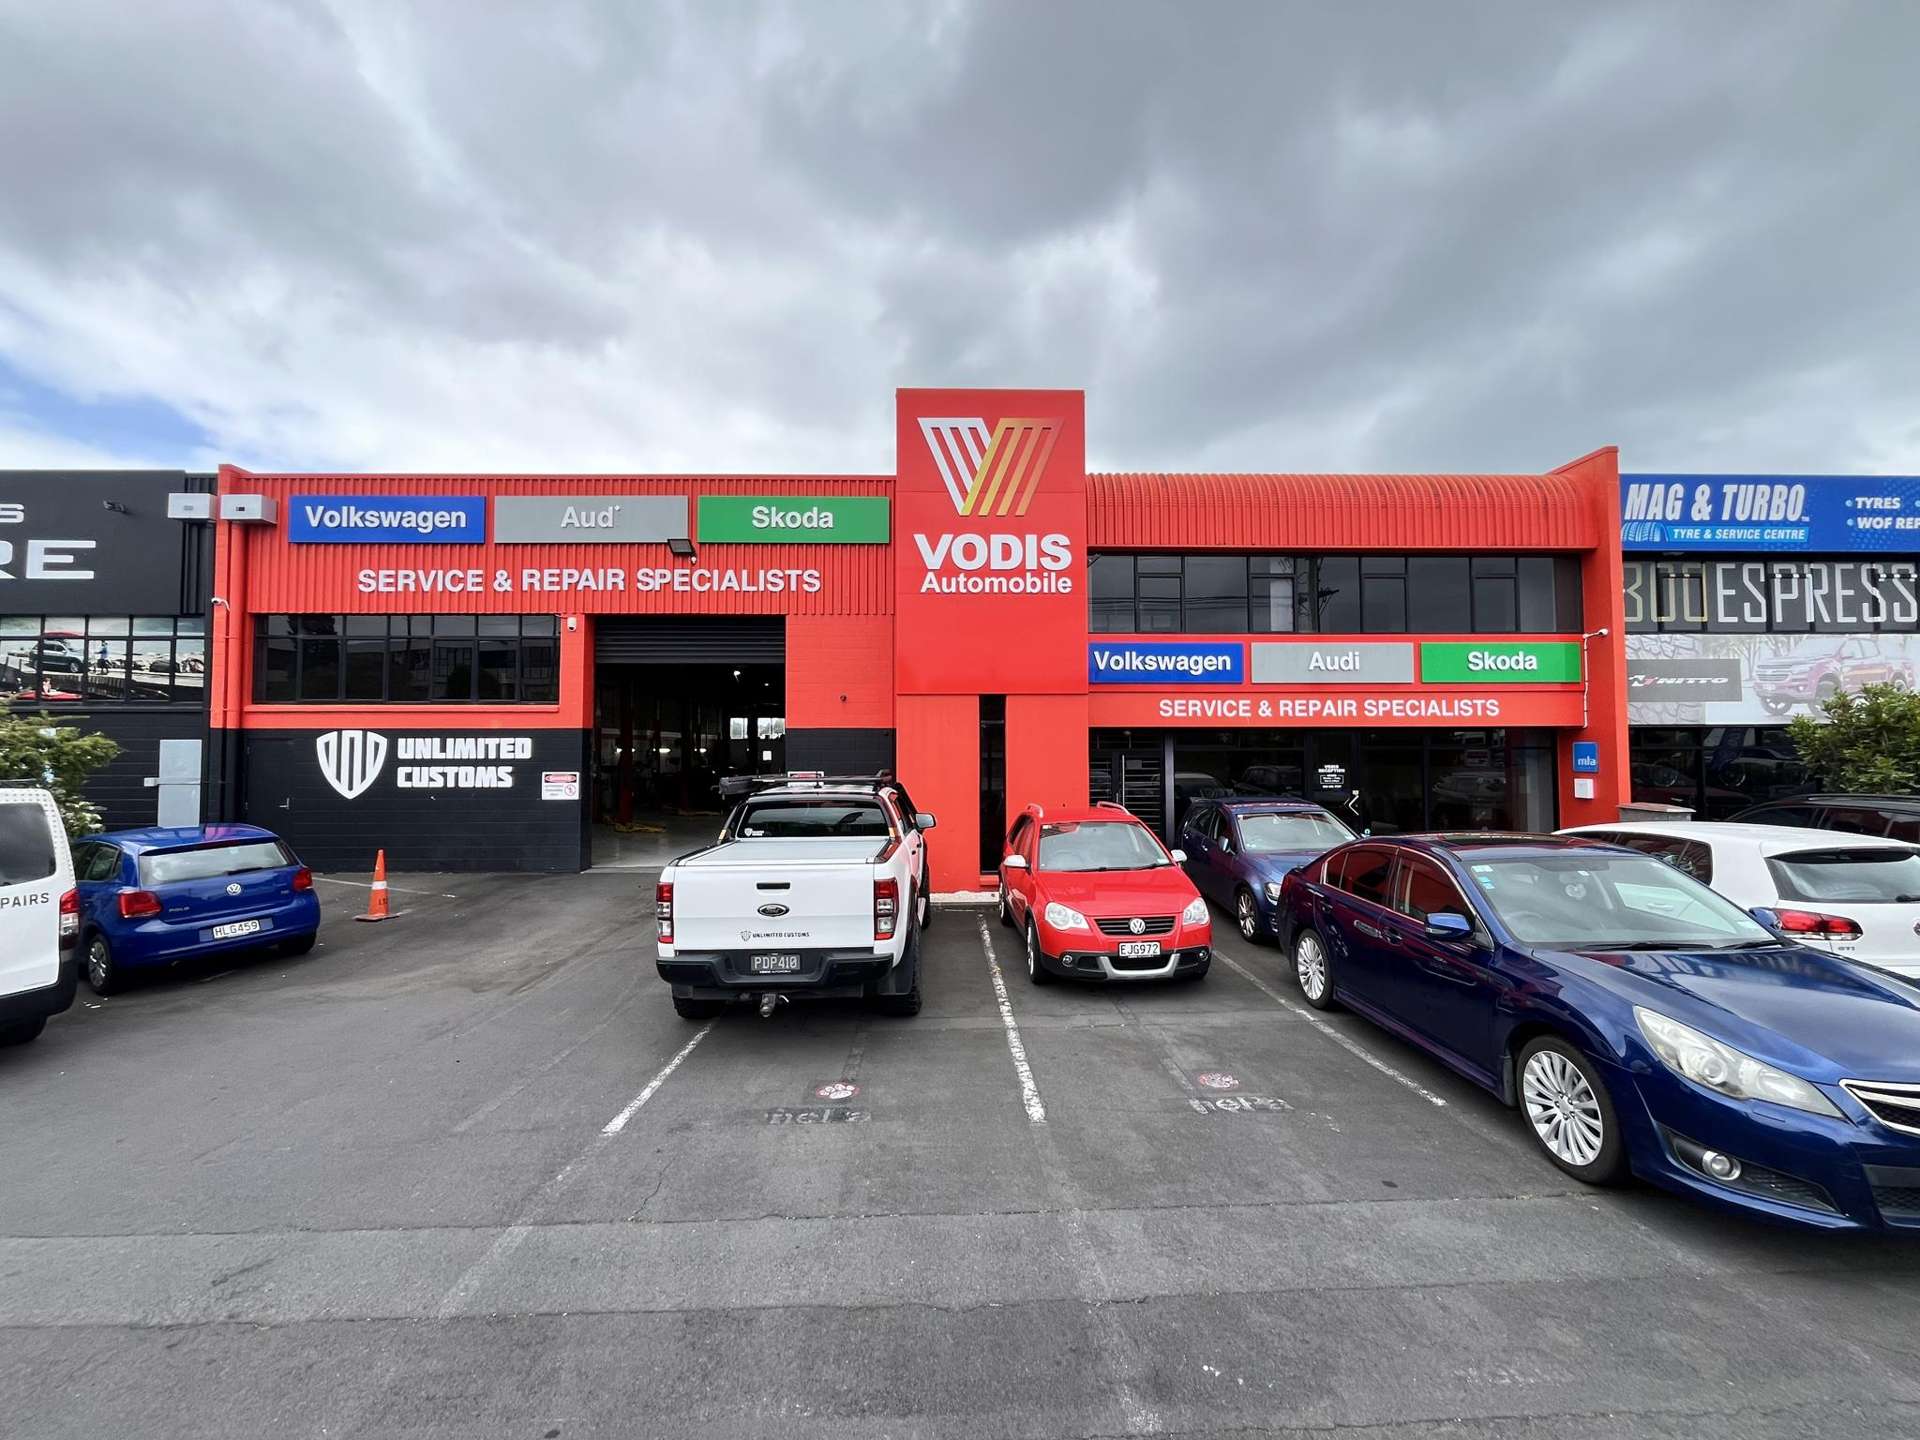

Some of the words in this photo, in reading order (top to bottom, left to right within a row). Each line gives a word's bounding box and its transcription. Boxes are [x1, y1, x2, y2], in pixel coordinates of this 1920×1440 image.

[1624, 483, 1684, 520] MAG
[1691, 484, 1712, 521] &
[1721, 484, 1805, 522] TURBO
[1856, 497, 1901, 509] TYRES
[305, 505, 467, 533] Volkswagen
[752, 506, 834, 528] Skoda
[1857, 517, 1892, 529] WOF
[1673, 529, 1700, 540] TYRE
[1703, 529, 1712, 540] &
[1715, 529, 1760, 540] SERVICE
[1763, 529, 1806, 540] CENTRE
[913, 534, 1072, 571] VODIS
[358, 568, 484, 593] SERVICE
[493, 570, 512, 592] &
[522, 568, 625, 592] REPAIR
[637, 568, 821, 593] SPECIALISTS
[921, 572, 1072, 593] Automobile
[1093, 651, 1231, 676] Volkswagen
[1308, 651, 1360, 671] Audi
[1468, 651, 1538, 671] Skoda
[1159, 699, 1251, 717] SERVICE
[1258, 700, 1272, 717] &
[1280, 699, 1357, 717] REPAIR
[1364, 699, 1499, 717] SPECIALISTS
[397, 738, 532, 759] UNLIMITED
[397, 766, 513, 788] CUSTOMS
[0, 892, 49, 909] PAIRS
[214, 921, 259, 938] HLG459
[1120, 944, 1159, 955] EJG972
[754, 956, 797, 969] PDP410
